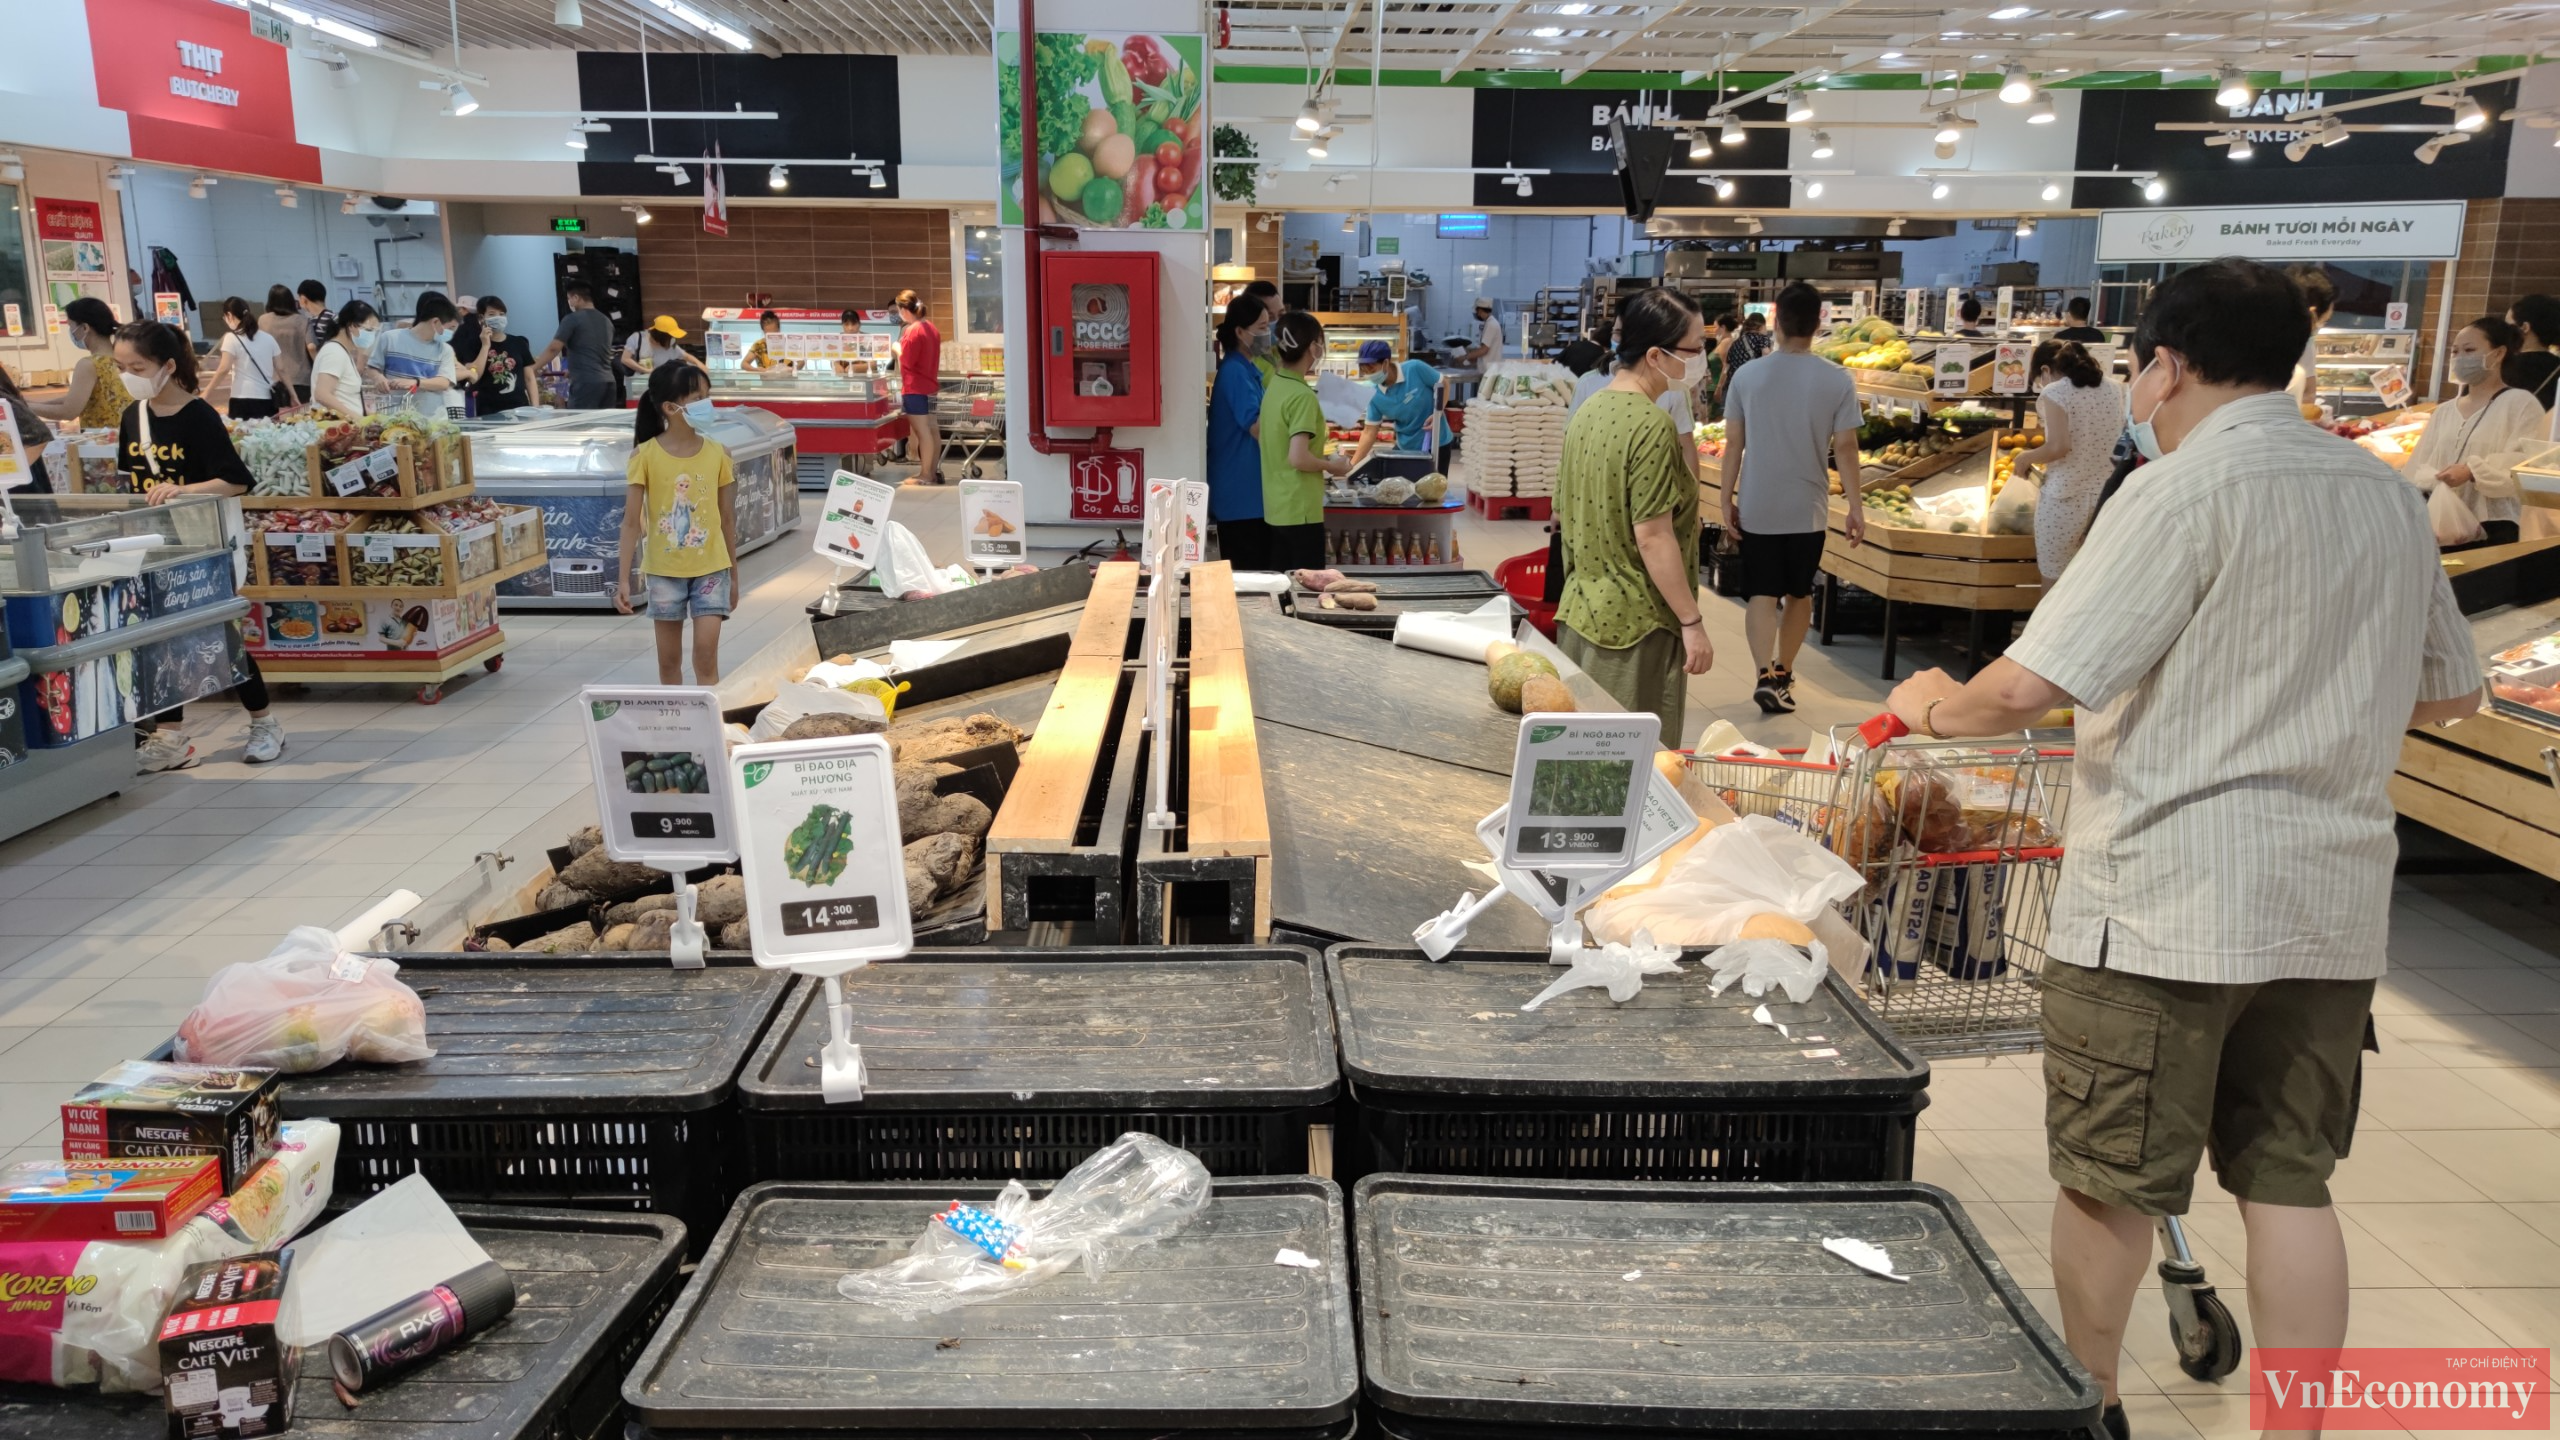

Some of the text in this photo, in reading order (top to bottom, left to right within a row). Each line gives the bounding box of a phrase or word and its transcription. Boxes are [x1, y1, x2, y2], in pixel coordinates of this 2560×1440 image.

[176, 40, 223, 77] THỊT
[170, 76, 239, 106] BUTCHERY
[2220, 216, 2414, 236] BÁNH TƯƠI MỖI NGÀY
[2266, 239, 2293, 247] Baked
[2321, 238, 2362, 247] Everyday
[1076, 322, 1126, 340] PCCC
[1077, 341, 1101, 349] HOSE
[1112, 505, 1140, 513] ABC
[659, 708, 681, 717] 3770
[1596, 740, 1611, 748] 660
[809, 761, 834, 772] ĐAO
[837, 759, 857, 771] ĐỊA
[801, 773, 853, 786] PHƯƠNG
[1905, 898, 1925, 941] ST24
[68, 1109, 99, 1122] VỊ CỰC
[69, 1122, 100, 1136] MẠNH
[135, 1126, 190, 1141] NESCAFÉ
[125, 1144, 160, 1157] CAFÉ
[0, 1272, 98, 1301] KORENO
[7, 1300, 52, 1312] JUMBO
[400, 1307, 445, 1339] AXE
[188, 1334, 244, 1353] NESCAFÉ
[178, 1346, 261, 1370] CAFÉ VIỆT
